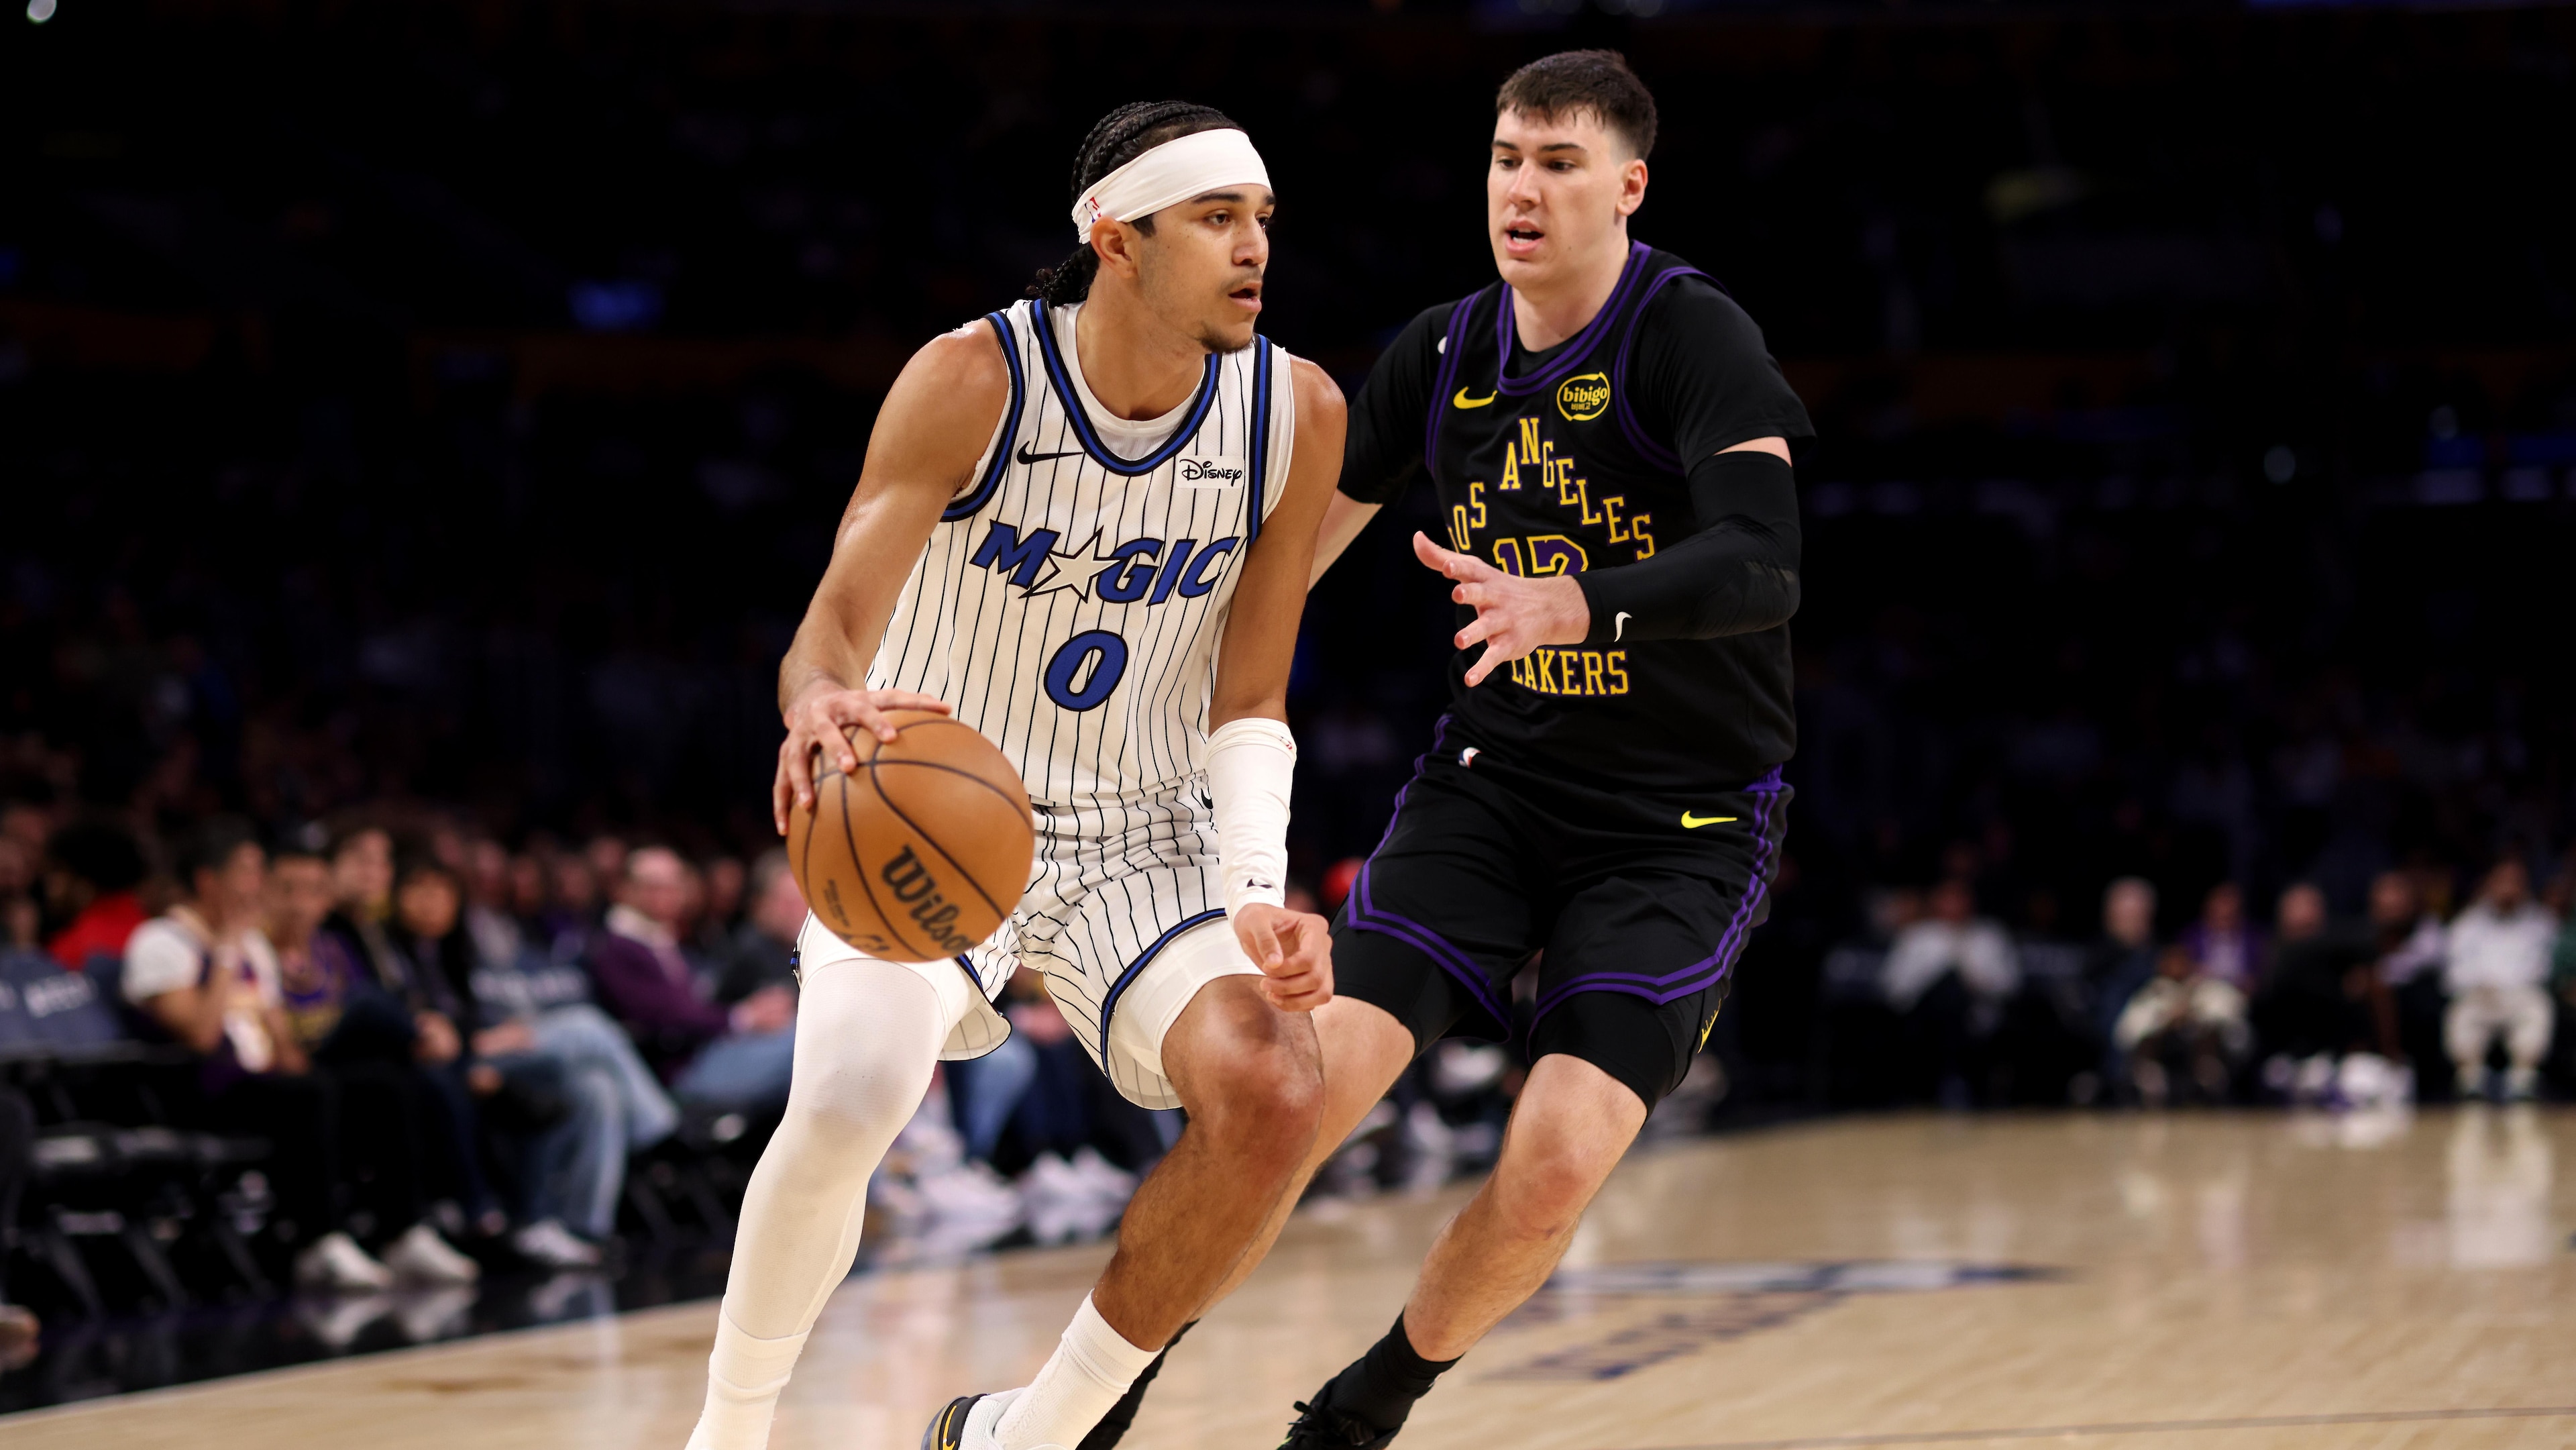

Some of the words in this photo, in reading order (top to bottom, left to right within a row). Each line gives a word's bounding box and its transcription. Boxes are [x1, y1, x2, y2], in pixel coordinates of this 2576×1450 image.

[1563, 386, 1607, 406] bibigo
[1499, 417, 1656, 561] ANGELES
[1044, 629, 1128, 712] 0
[1511, 648, 1629, 696] LAKERS
